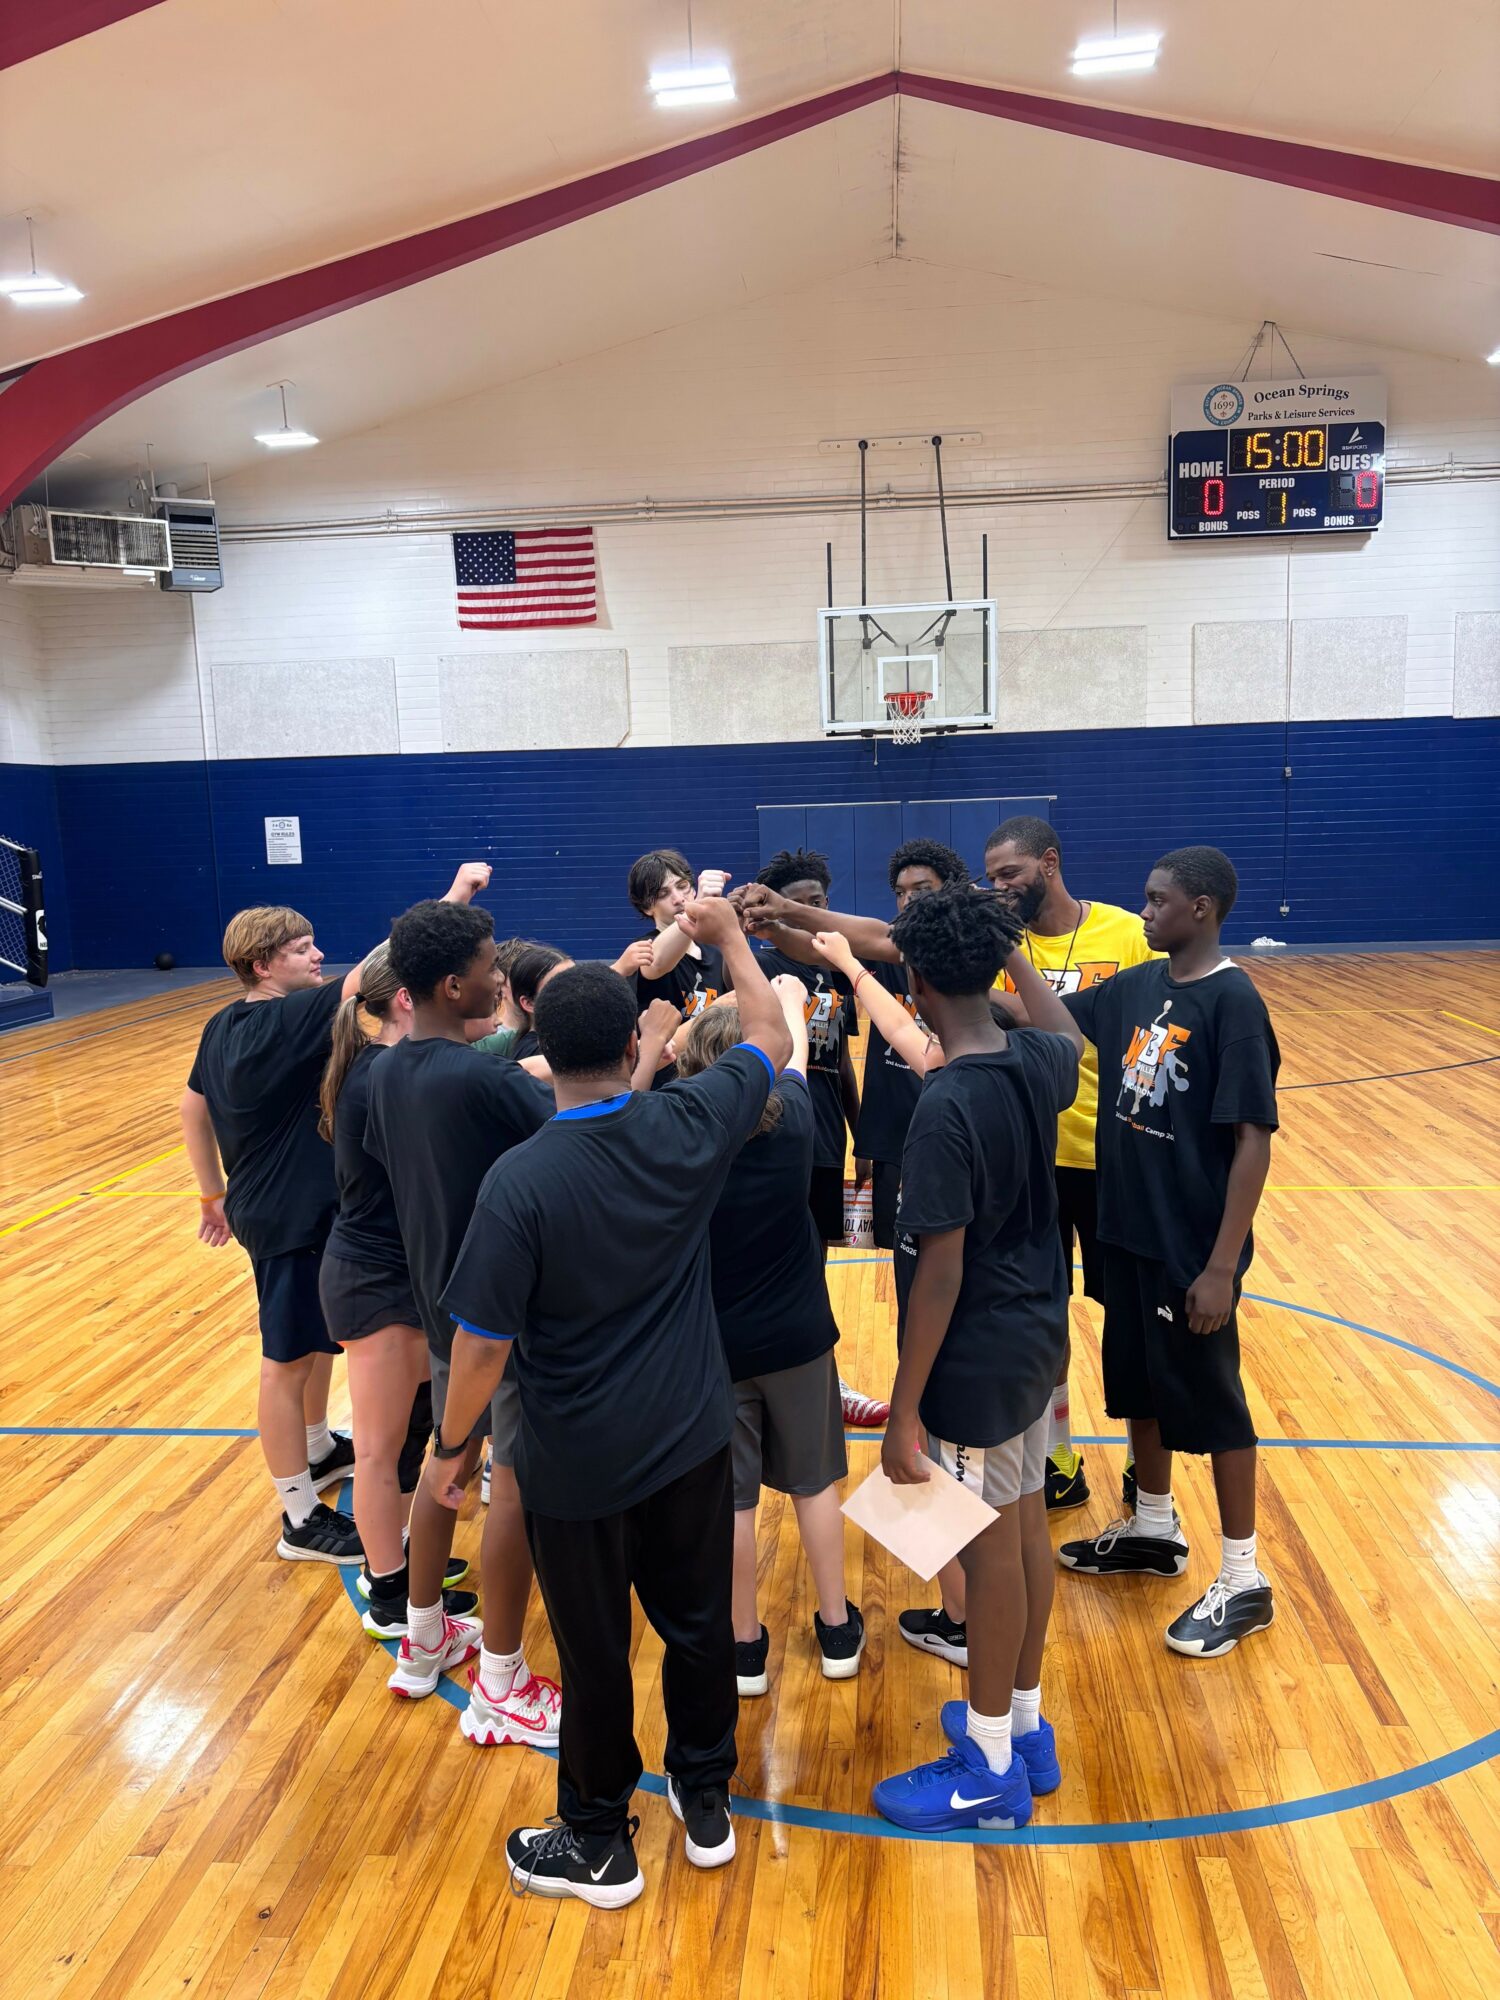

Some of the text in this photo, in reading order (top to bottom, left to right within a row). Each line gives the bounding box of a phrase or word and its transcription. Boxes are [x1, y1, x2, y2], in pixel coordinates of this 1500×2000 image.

[1254, 384, 1350, 403] Ocean Springs
[1213, 401, 1235, 410] 1699
[1248, 407, 1355, 421] Parks & Leisure Services
[1245, 430, 1324, 469] 15:00
[1179, 461, 1224, 479] HOME
[1329, 453, 1380, 471] GUEST
[1259, 478, 1295, 489] PERIOD
[1356, 470, 1377, 508] 0
[1204, 479, 1224, 515] 0
[1236, 510, 1260, 520] POSS
[1281, 492, 1287, 524] 1
[1293, 508, 1317, 517] POSS
[1199, 521, 1229, 532] BONUS
[1324, 515, 1355, 526] BONUS
[1123, 1022, 1193, 1069] WBF
[1145, 1126, 1165, 1139] Camp
